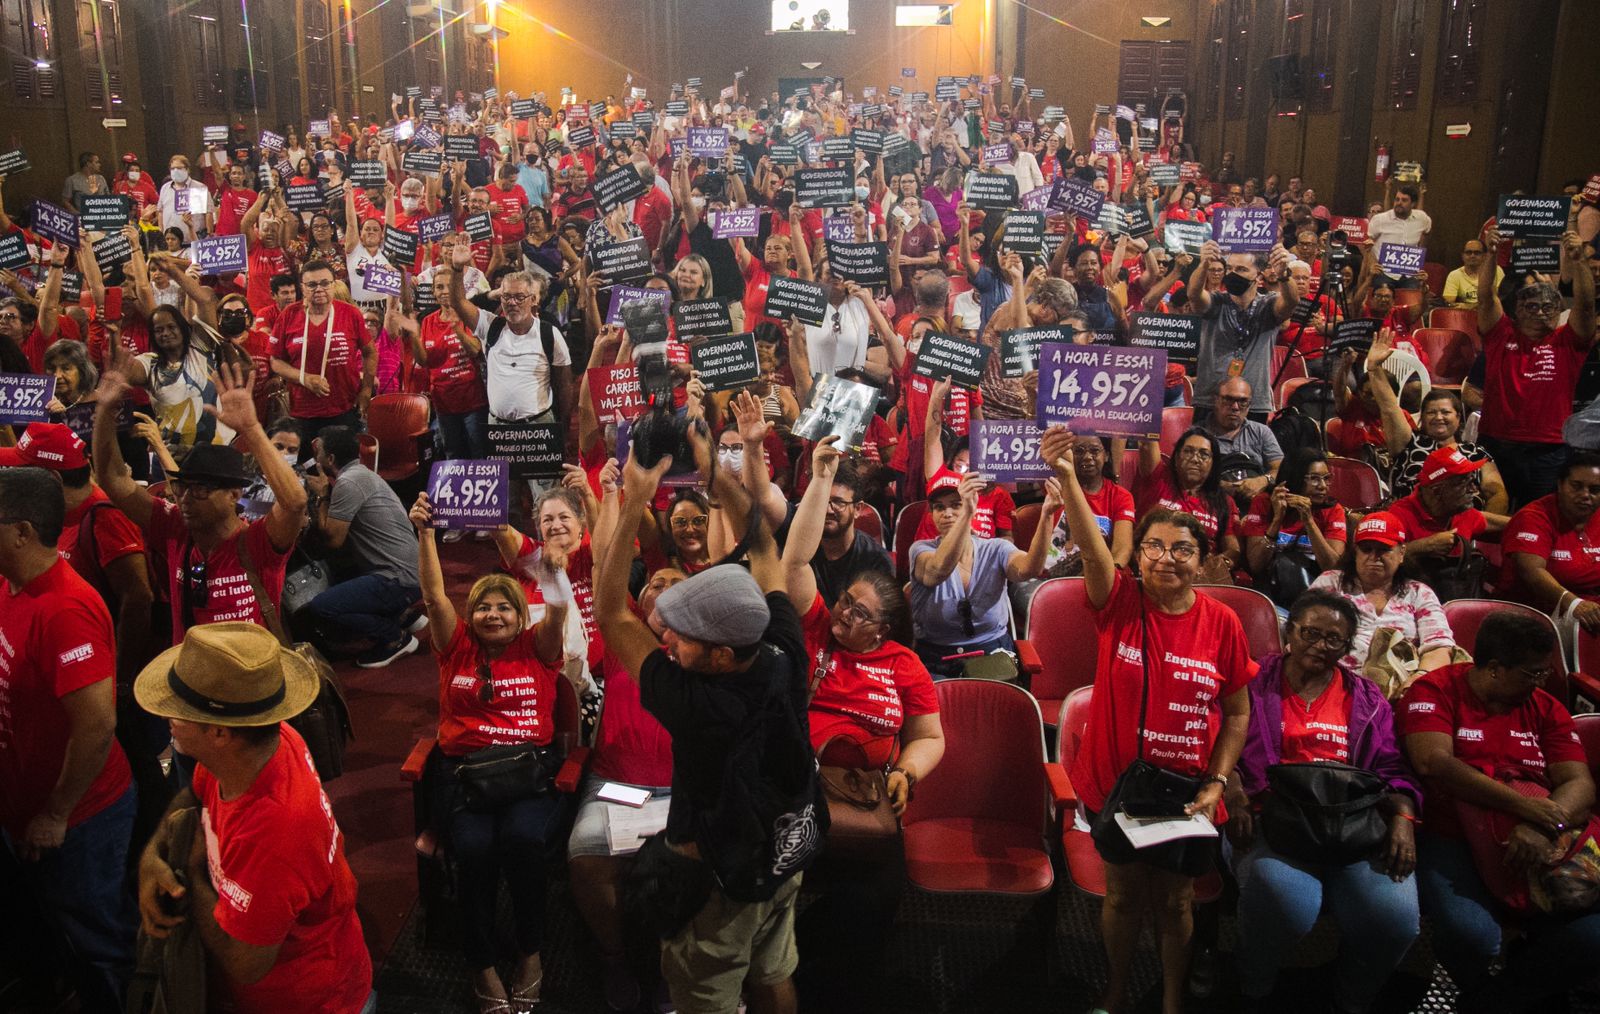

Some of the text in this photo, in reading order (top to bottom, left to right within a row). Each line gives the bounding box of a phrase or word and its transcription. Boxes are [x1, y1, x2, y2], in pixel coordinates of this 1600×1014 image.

[691, 135, 725, 148] 14,95%
[1056, 188, 1098, 211] 14,95%
[1220, 210, 1227, 218] A
[1228, 210, 1247, 218] HORA
[1254, 210, 1274, 219] ESSA!
[38, 208, 74, 236] 14,95%
[422, 220, 451, 235] 14,95%
[720, 214, 754, 230] 14,95%
[1221, 220, 1272, 238] 14,95%
[198, 245, 241, 263] 14,95%
[1384, 250, 1421, 266] 14,95%
[626, 290, 642, 299] HORA
[648, 291, 666, 301] ESSA!
[768, 297, 790, 307] CARREIRA
[798, 302, 824, 314] EDUCAÇÃO!
[1164, 331, 1176, 339] PISO
[1131, 338, 1196, 350] CARREIRA DA EDUCAÇÃO!
[724, 353, 743, 365] PISO NA
[918, 354, 980, 377] CARREIRA DA EDUCAÇÃO!
[952, 352, 972, 365] PISO NA
[1052, 350, 1154, 370] A HORA É ESSA!
[610, 367, 639, 381] PISO E
[720, 360, 754, 375] DA EDUCAÇÃO!
[0, 376, 48, 387] HORA É ESSA!
[1052, 369, 1152, 408] 14,95%
[0, 386, 44, 408] 4,95%
[600, 395, 632, 410] VALE A
[1046, 406, 1152, 424] NA CARREIRA DA EDUCAÇÃO!
[980, 423, 1023, 435] A HORA É
[37, 450, 64, 462] SINTEPE
[527, 454, 562, 462] EDUCAÇÃO!
[437, 462, 500, 477] A HORA É ESSA!
[434, 478, 498, 507] 14,95%
[472, 508, 502, 517] EDUCAÇÃO!
[212, 584, 254, 598] eu luto,
[236, 595, 256, 606] sou
[60, 644, 94, 664] SINTEPE
[1173, 670, 1189, 681] eu
[500, 688, 537, 698] eu luto,
[521, 698, 536, 706] sou
[518, 718, 539, 726] pela
[1185, 719, 1208, 731] pela
[1316, 732, 1330, 742] eu
[1151, 748, 1176, 758] Paulo
[222, 878, 250, 908] SINTEPE
